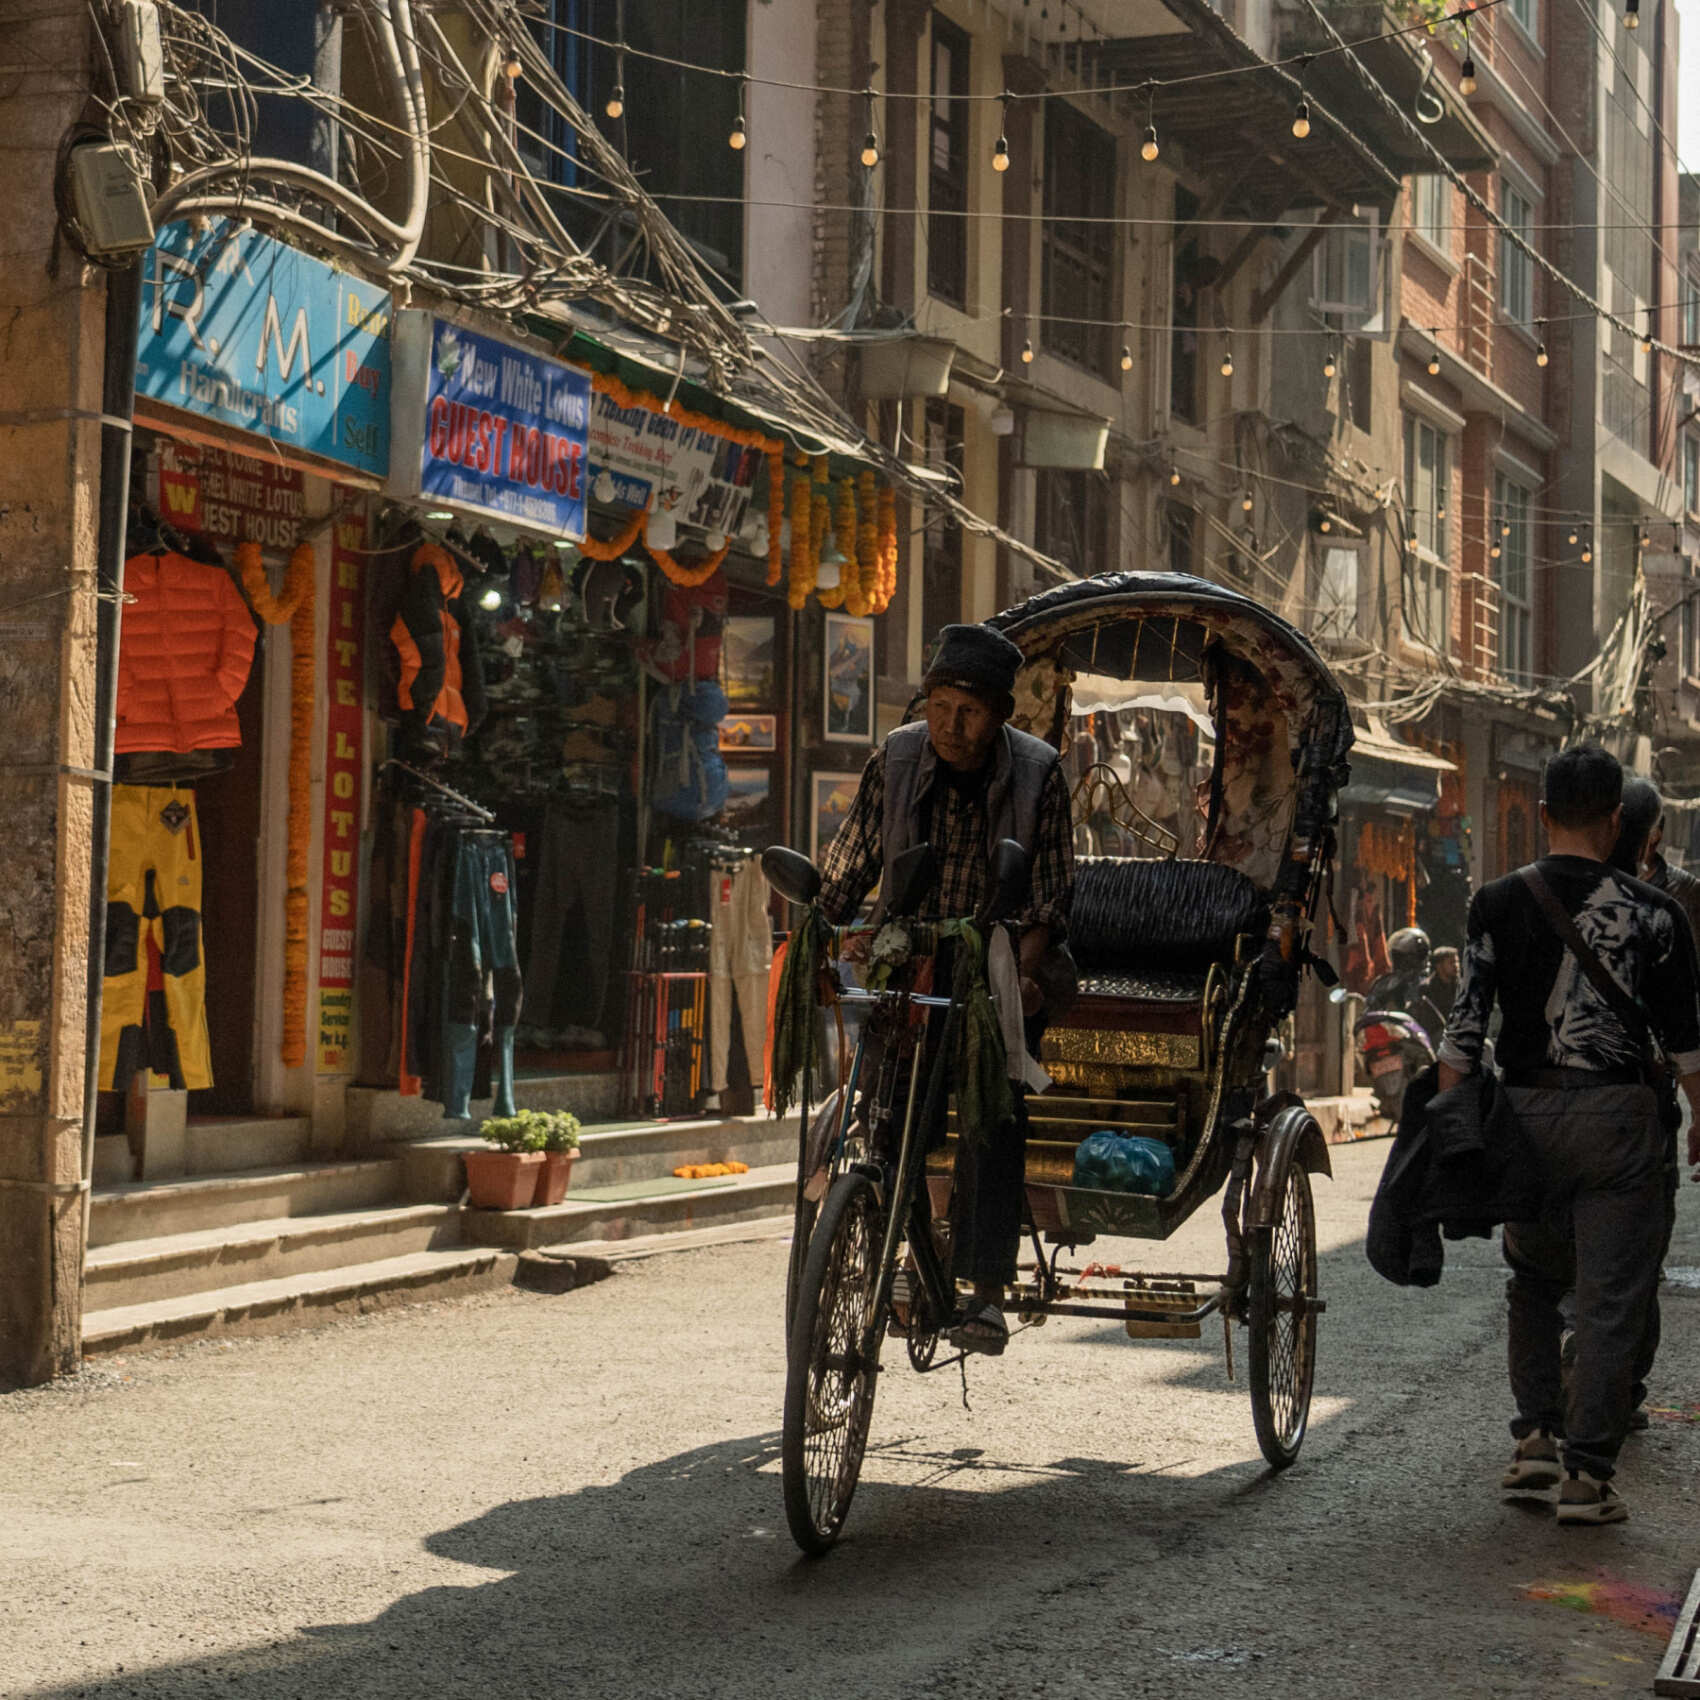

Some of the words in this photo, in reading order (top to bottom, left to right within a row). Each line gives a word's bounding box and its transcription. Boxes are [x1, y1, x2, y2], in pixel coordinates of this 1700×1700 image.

[180, 360, 298, 434] Handicrafts
[345, 349, 381, 399] Buy
[460, 344, 498, 399] New
[501, 356, 542, 413] White
[545, 373, 583, 431] Lotus
[344, 416, 378, 457] Sell
[430, 395, 506, 476] GUEST
[509, 424, 582, 499] HOUSE
[330, 732, 355, 917] LOTUS
